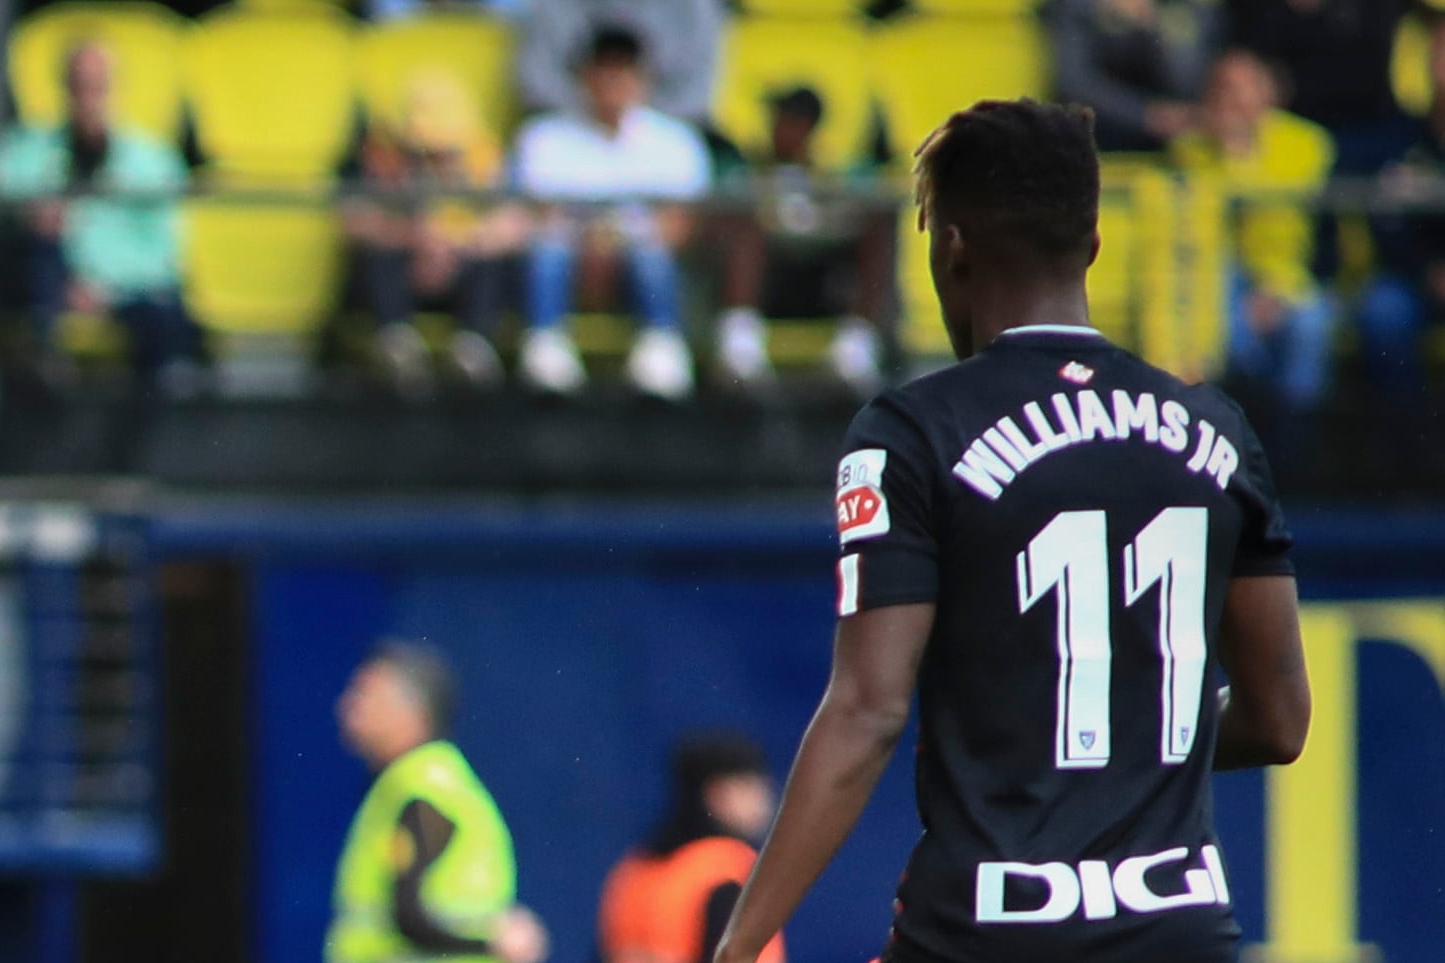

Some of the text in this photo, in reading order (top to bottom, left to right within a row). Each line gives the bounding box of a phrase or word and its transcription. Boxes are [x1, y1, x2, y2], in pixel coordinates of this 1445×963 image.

[952, 389, 1239, 501] WILLIAMS JR
[1016, 507, 1208, 769] 11
[975, 844, 1230, 923] DIGI
